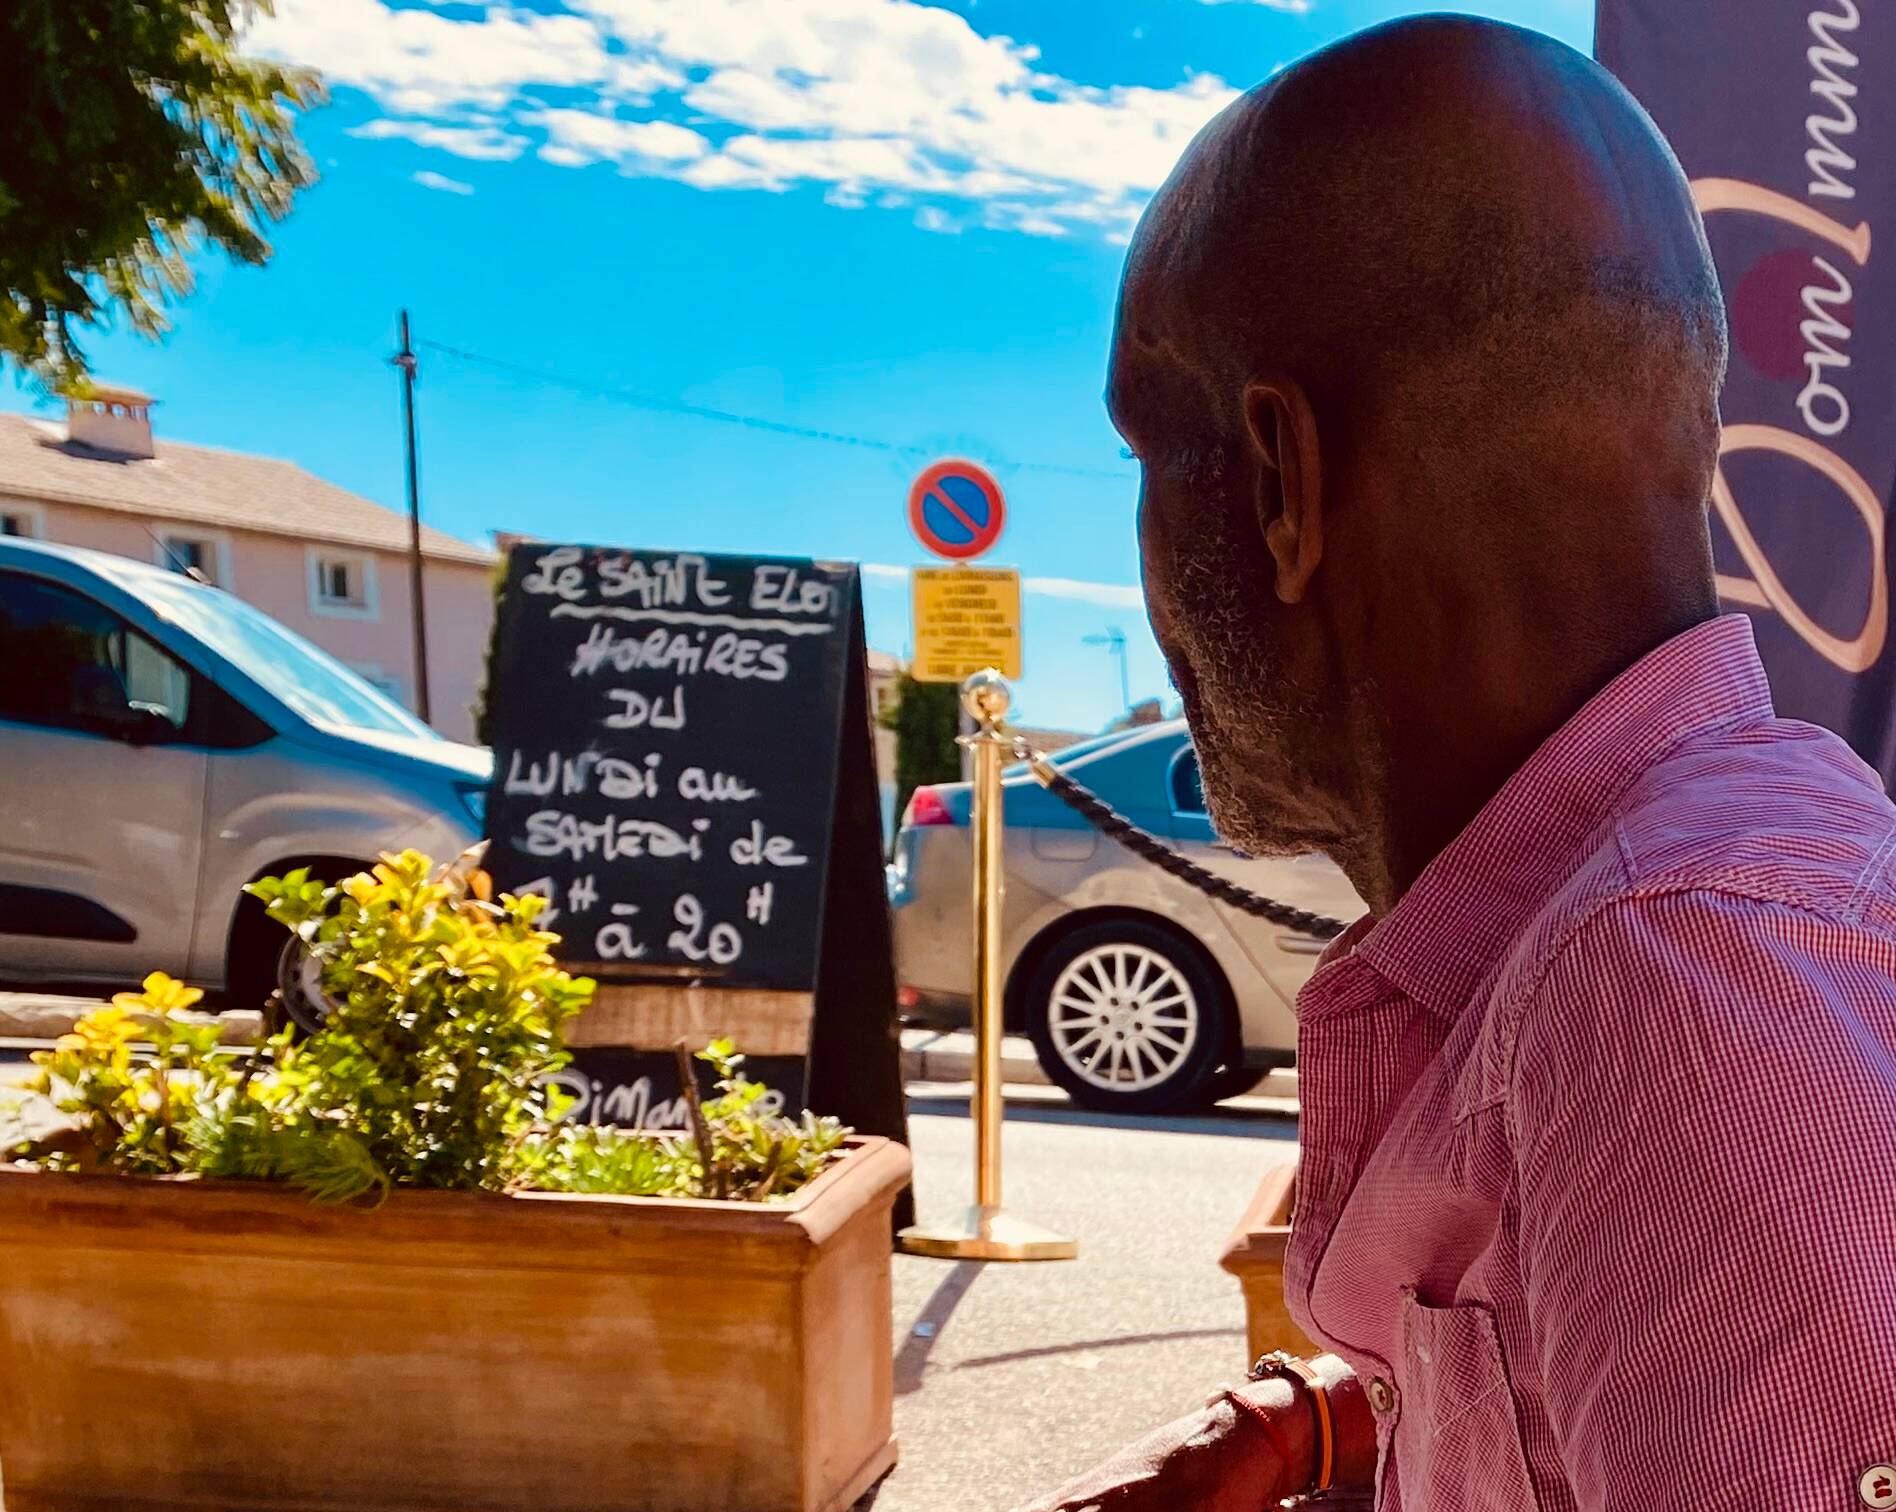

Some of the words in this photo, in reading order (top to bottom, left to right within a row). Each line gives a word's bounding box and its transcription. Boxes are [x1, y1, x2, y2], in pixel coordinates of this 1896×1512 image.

[522, 547, 590, 601] Le
[601, 684, 686, 731] DU
[729, 818, 809, 867] de
